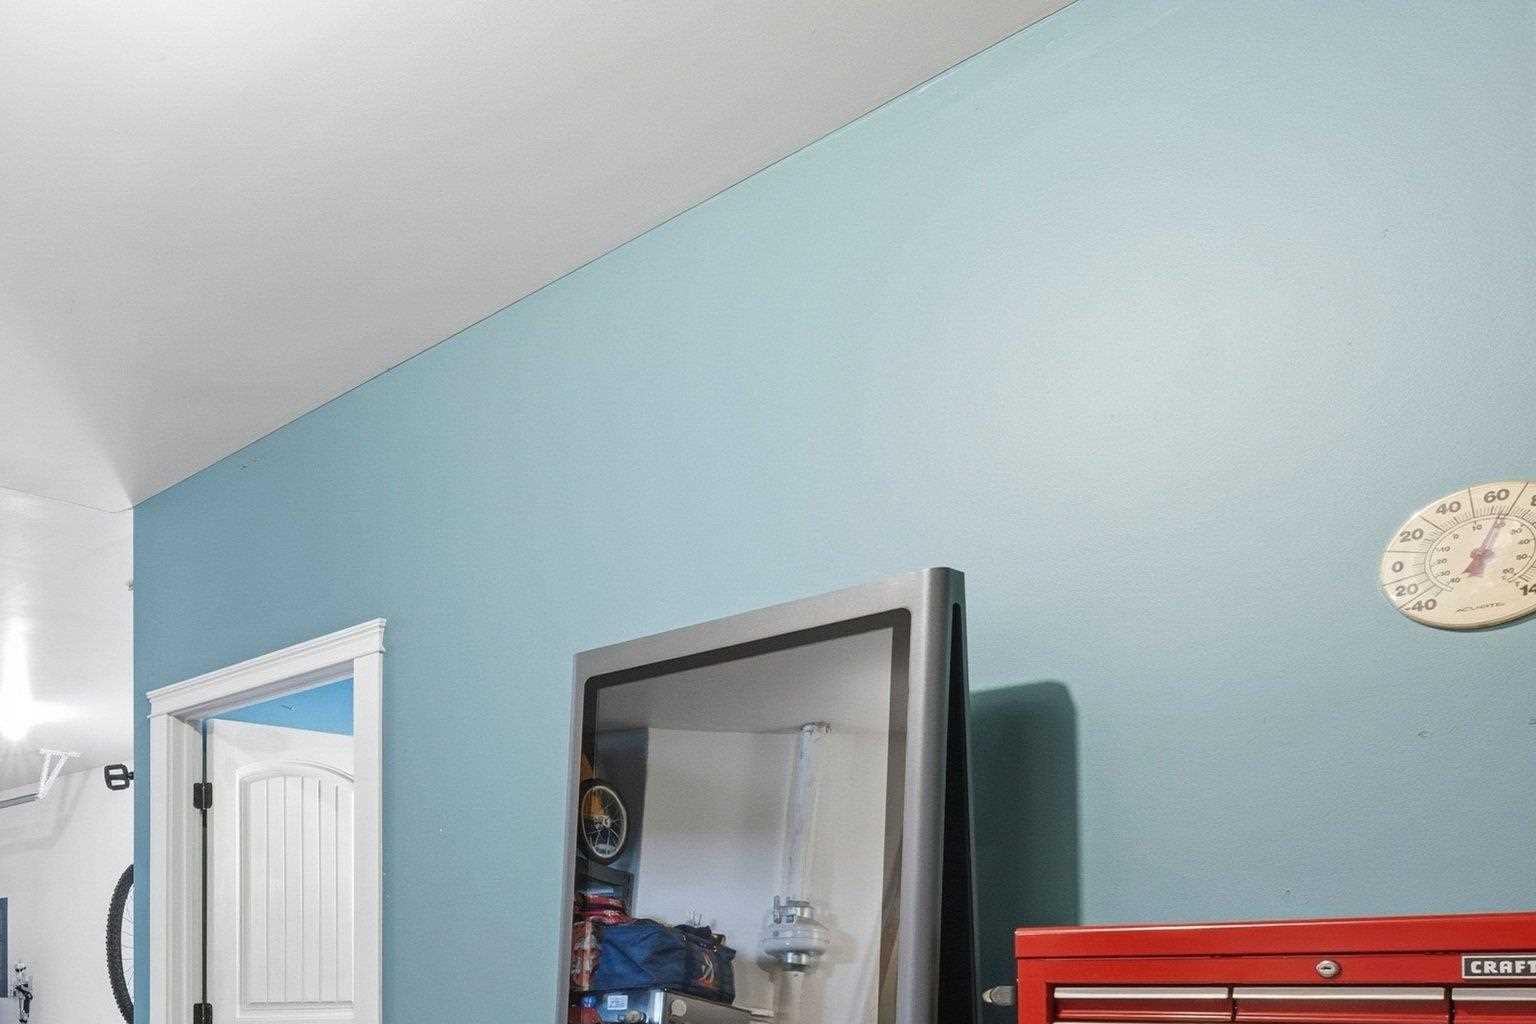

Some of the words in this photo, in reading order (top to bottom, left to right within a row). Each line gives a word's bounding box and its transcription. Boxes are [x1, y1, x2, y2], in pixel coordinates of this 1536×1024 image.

[1483, 488, 1510, 504] 60
[1435, 501, 1462, 515] 40
[1399, 528, 1425, 544] 20
[1391, 560, 1404, 573] 0
